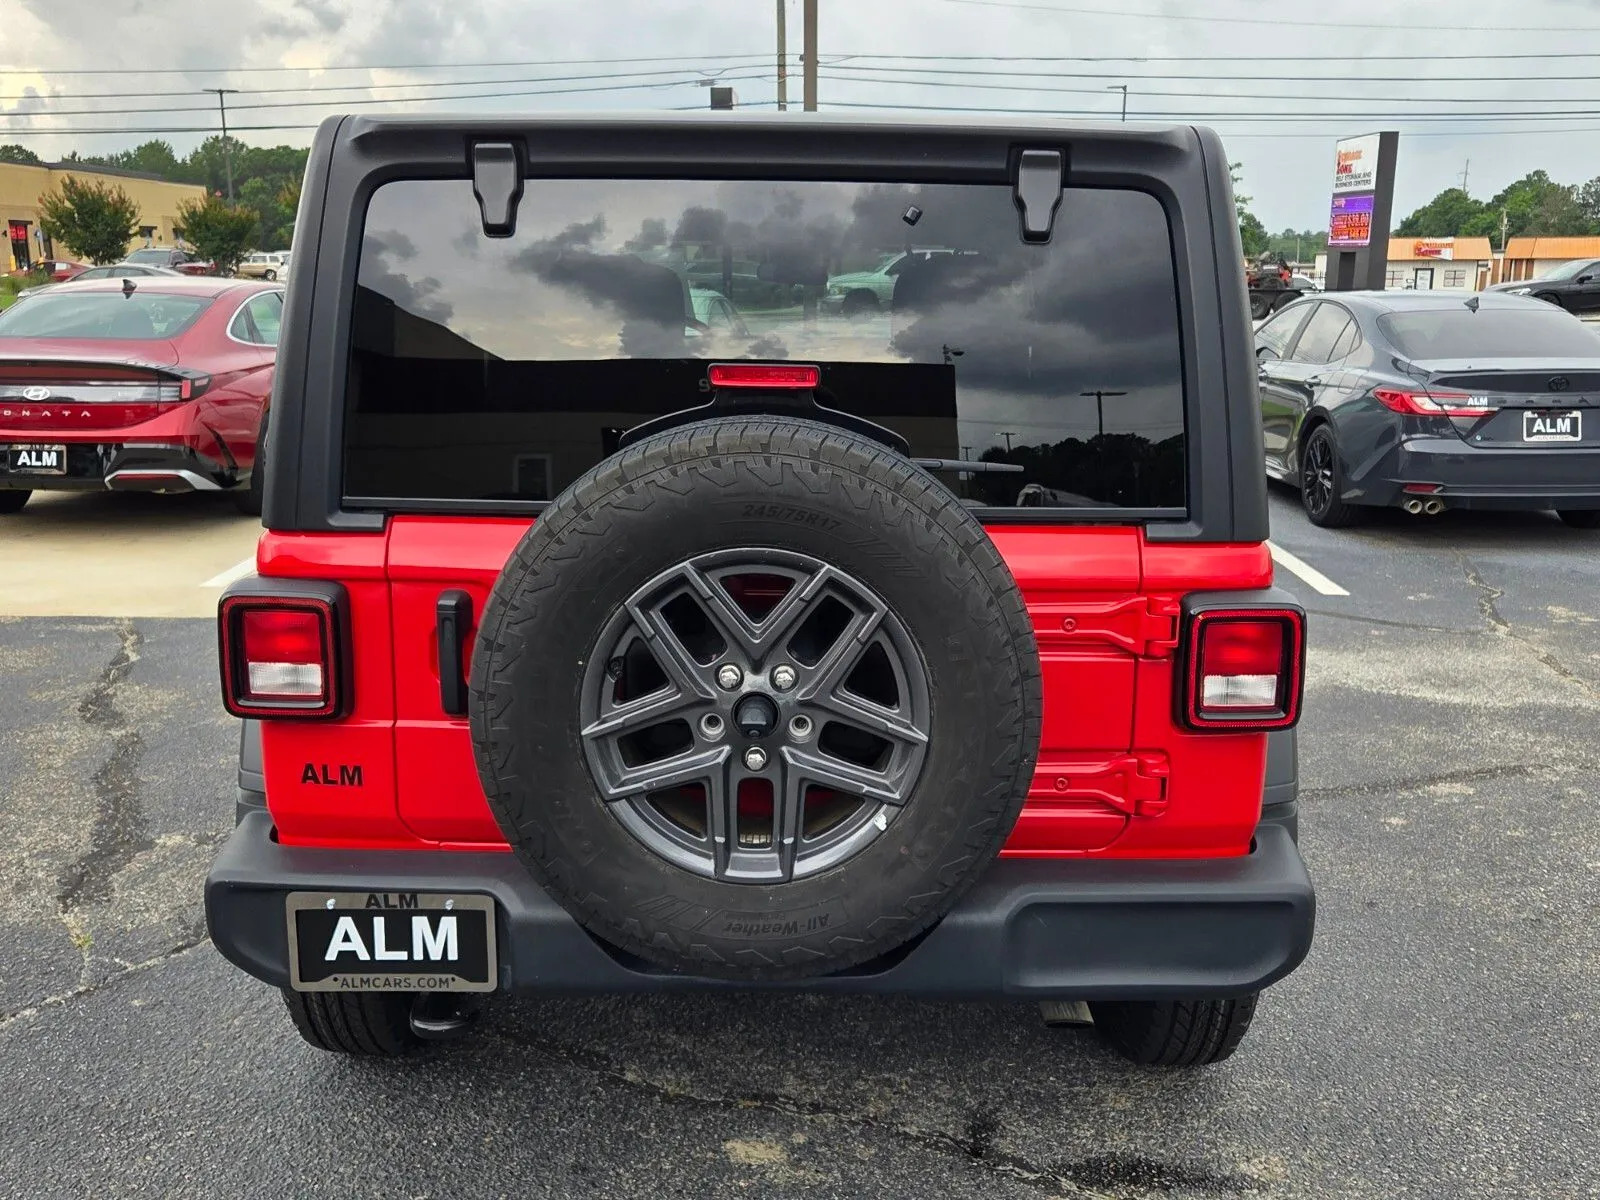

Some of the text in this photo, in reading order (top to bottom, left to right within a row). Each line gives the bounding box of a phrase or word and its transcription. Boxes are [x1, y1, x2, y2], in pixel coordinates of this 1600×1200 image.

[1532, 418, 1571, 433] ALM
[17, 450, 57, 467] ALM
[742, 504, 843, 531] 245/75R17
[301, 763, 363, 787] ALM
[365, 893, 419, 909] ALM
[324, 915, 459, 961] ALM
[340, 976, 450, 989] ALMCARS.COM
